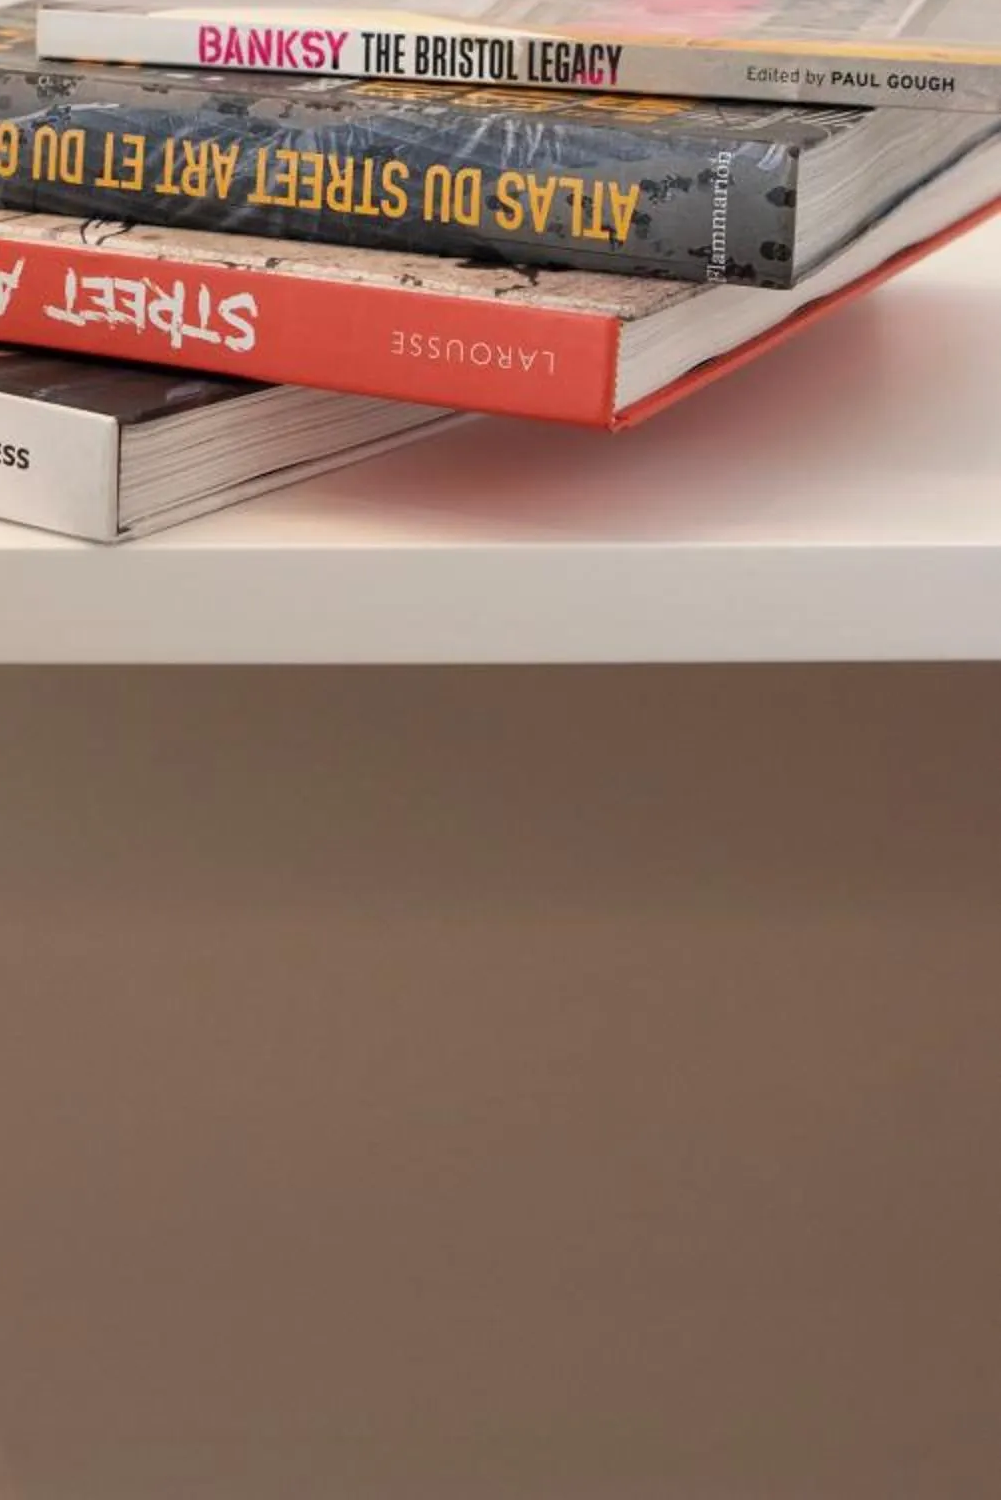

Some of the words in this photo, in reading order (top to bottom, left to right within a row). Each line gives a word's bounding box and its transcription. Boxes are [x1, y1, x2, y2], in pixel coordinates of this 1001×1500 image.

[198, 26, 349, 71] BANKSY
[360, 31, 407, 74] THE
[413, 35, 519, 82] BRISTOL
[525, 39, 623, 87] LEGACY
[746, 66, 799, 83] Edited
[805, 70, 825, 86] by
[831, 72, 879, 88] PAUL
[887, 75, 955, 92] GOUGH
[33, 124, 86, 185] DU
[95, 131, 145, 192] ET
[155, 136, 241, 200] ART
[245, 148, 409, 219] STREET
[424, 164, 483, 225] DU
[495, 171, 640, 241] ATLAS
[706, 151, 732, 284] Flammarion
[44, 268, 259, 352] STREET
[392, 331, 556, 375] LAROUSSE
